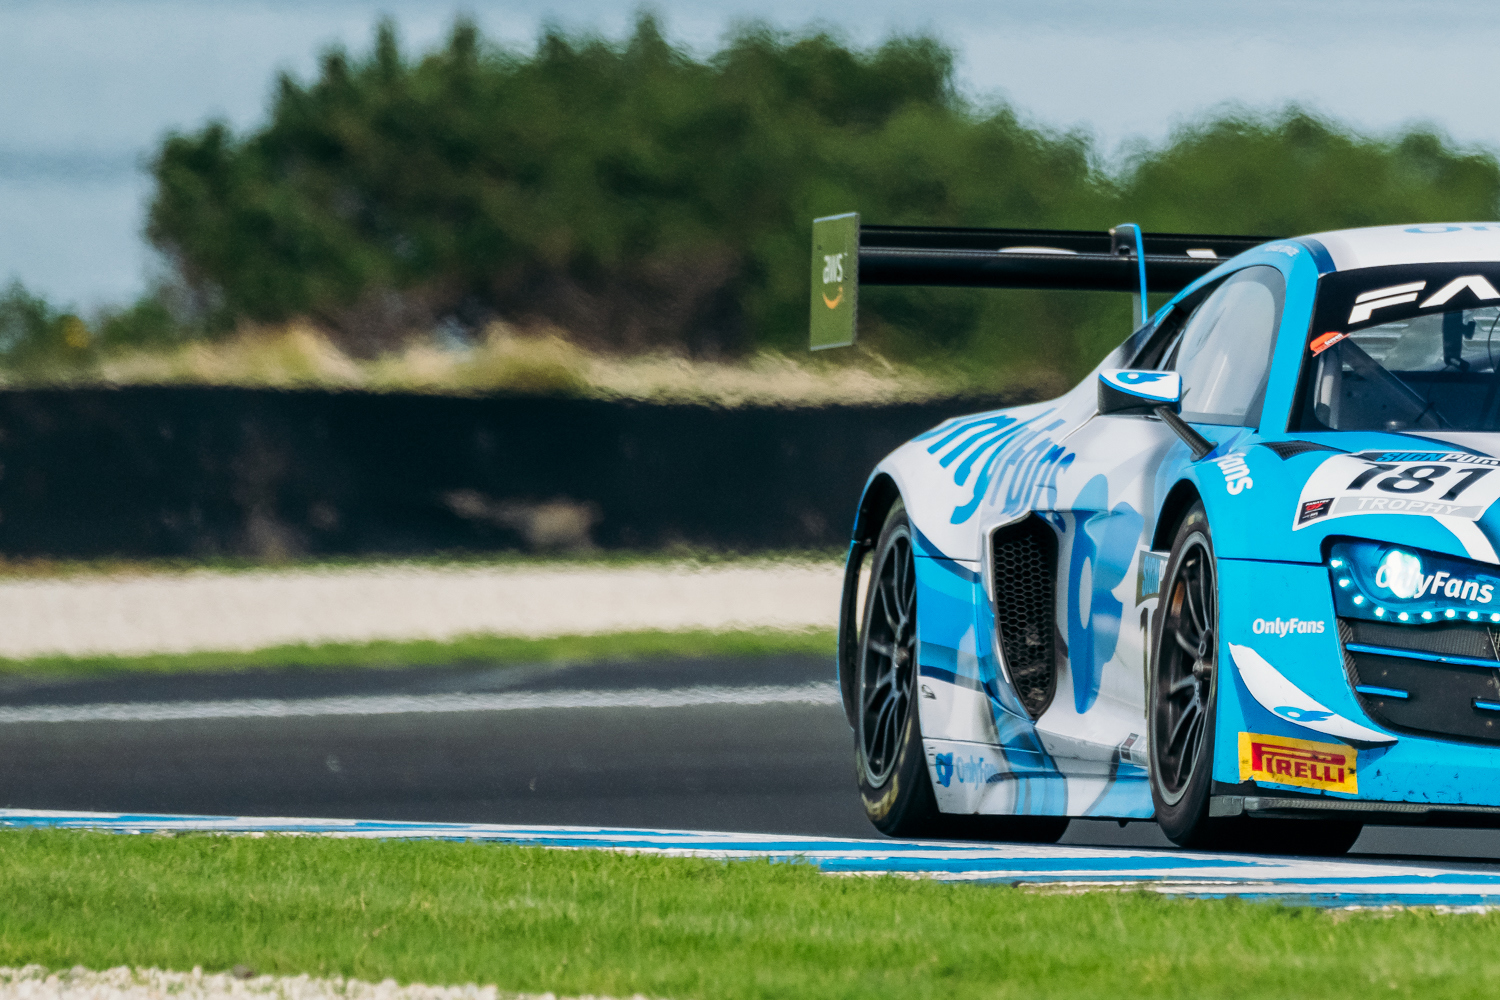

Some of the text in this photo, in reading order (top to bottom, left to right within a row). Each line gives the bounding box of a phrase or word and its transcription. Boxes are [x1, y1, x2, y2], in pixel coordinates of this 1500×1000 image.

[823, 253, 843, 284] aws
[1345, 461, 1496, 502] 181
[1357, 496, 1462, 515] TROPHY
[1375, 564, 1495, 604] OyFans
[1252, 617, 1326, 639] OnlyFans
[1251, 742, 1346, 783] PIRELLI
